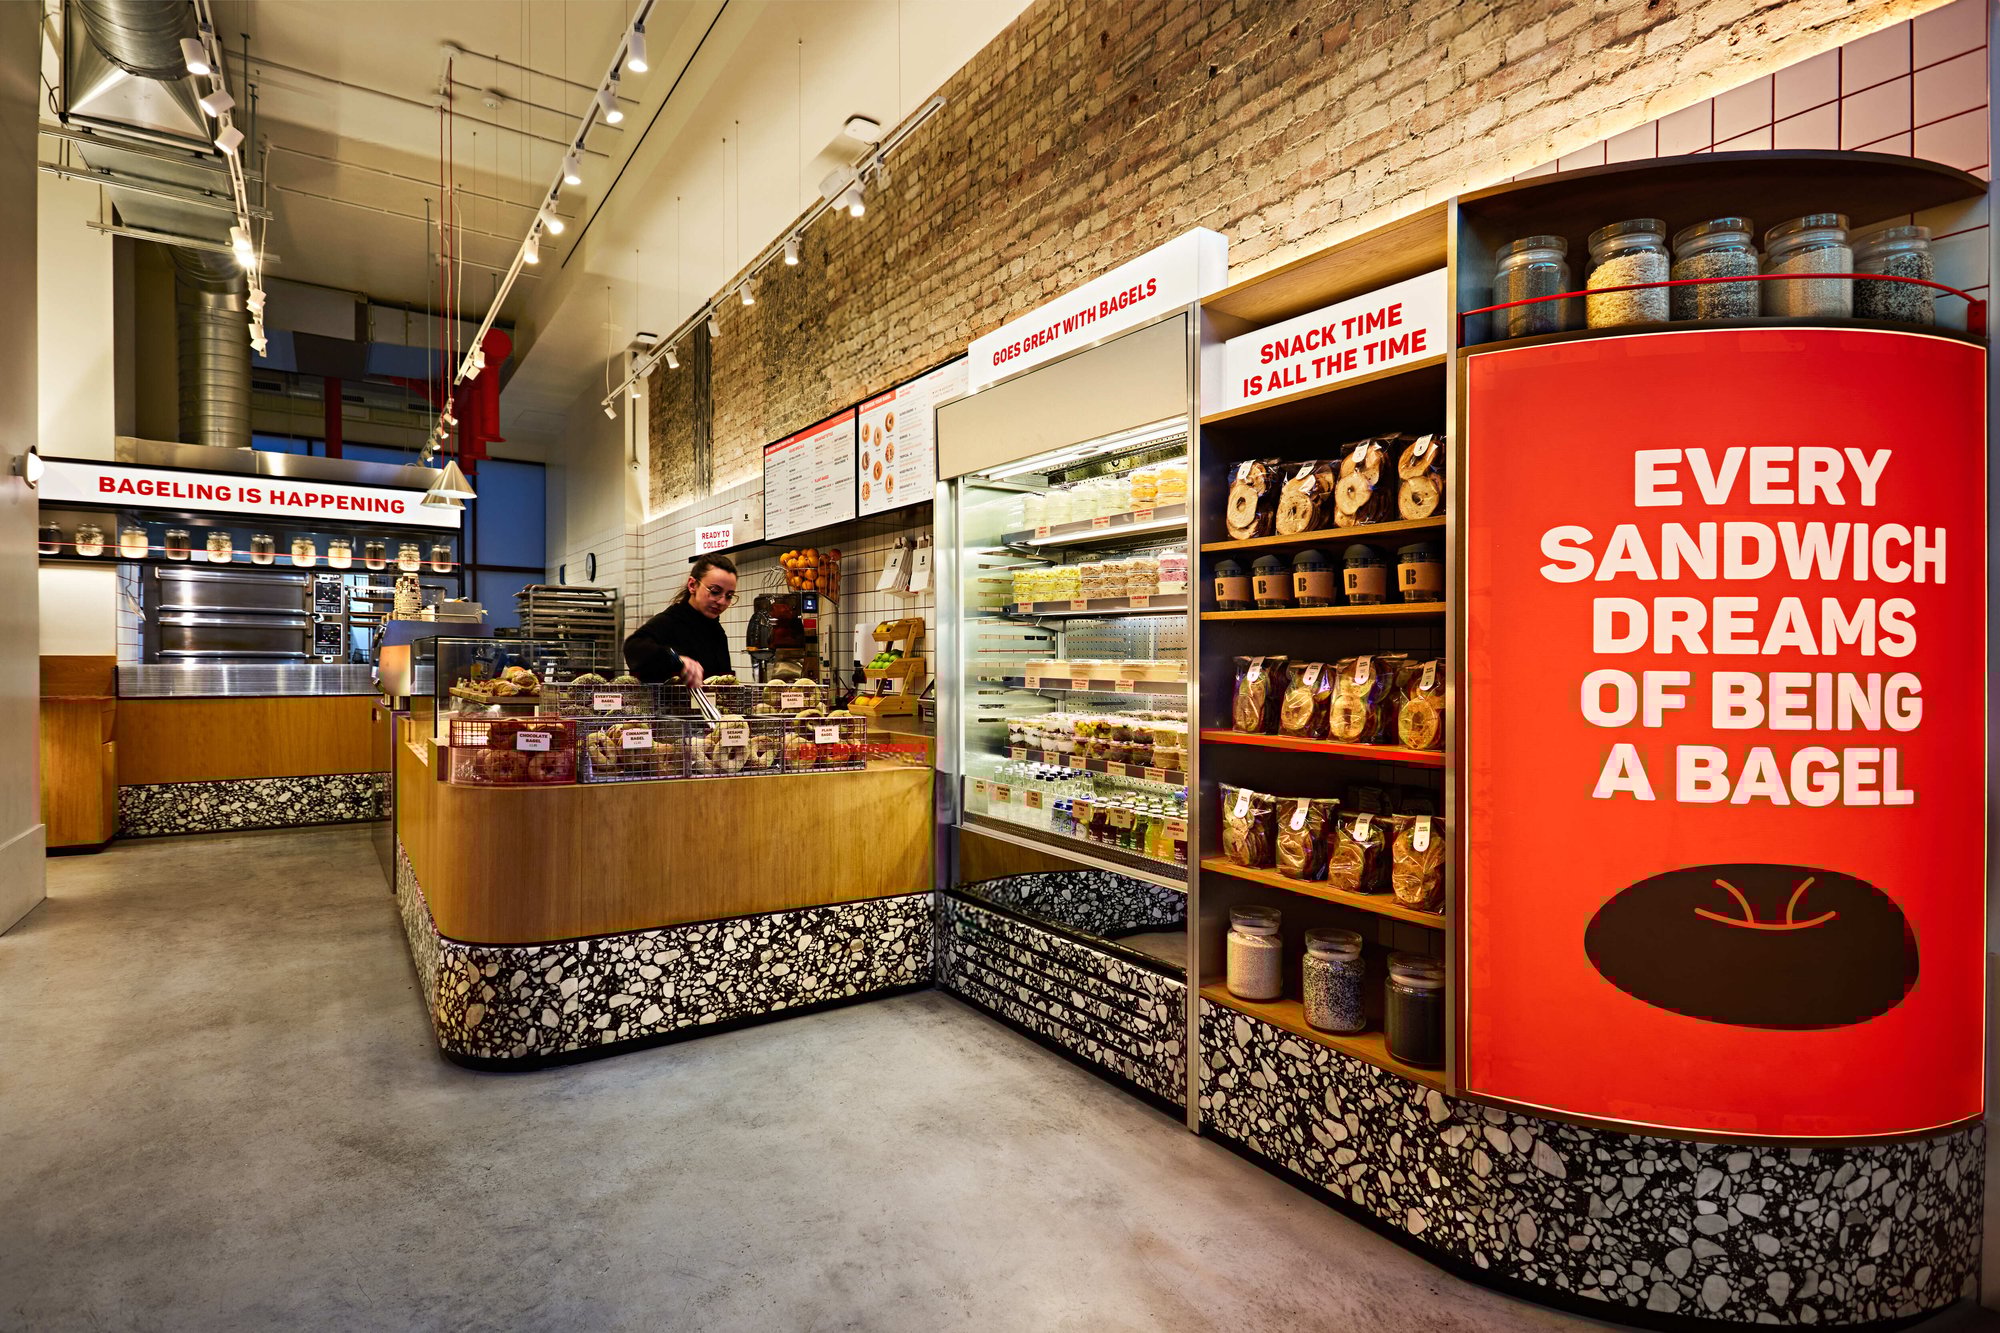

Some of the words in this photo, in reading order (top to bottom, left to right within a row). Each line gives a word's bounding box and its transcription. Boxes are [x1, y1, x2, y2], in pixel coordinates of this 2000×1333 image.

[992, 341, 1021, 366] GOES
[1022, 322, 1061, 353] GREAT
[1062, 305, 1097, 335] WITH
[1099, 277, 1157, 319] BAGELS
[1260, 323, 1337, 365] SNACK
[1341, 302, 1403, 340] TIME
[1243, 375, 1263, 398] IS
[1266, 363, 1308, 392] ALL
[1311, 347, 1358, 379] THE
[1362, 327, 1427, 365] TIME
[98, 476, 232, 502] BAGELING
[238, 487, 263, 504] IS
[269, 489, 405, 515] HAPPENING
[1634, 446, 1892, 507] EVERY
[701, 531, 721, 540] READY
[722, 529, 730, 538] TO
[702, 539, 729, 549] COLLECT
[1539, 521, 1946, 584] SANDWICH
[1593, 596, 1917, 658] DREAMS
[1580, 668, 1691, 728] OF
[1711, 671, 1923, 732] BEING
[1592, 743, 1656, 801] A
[1676, 744, 1914, 807] BAGEL
